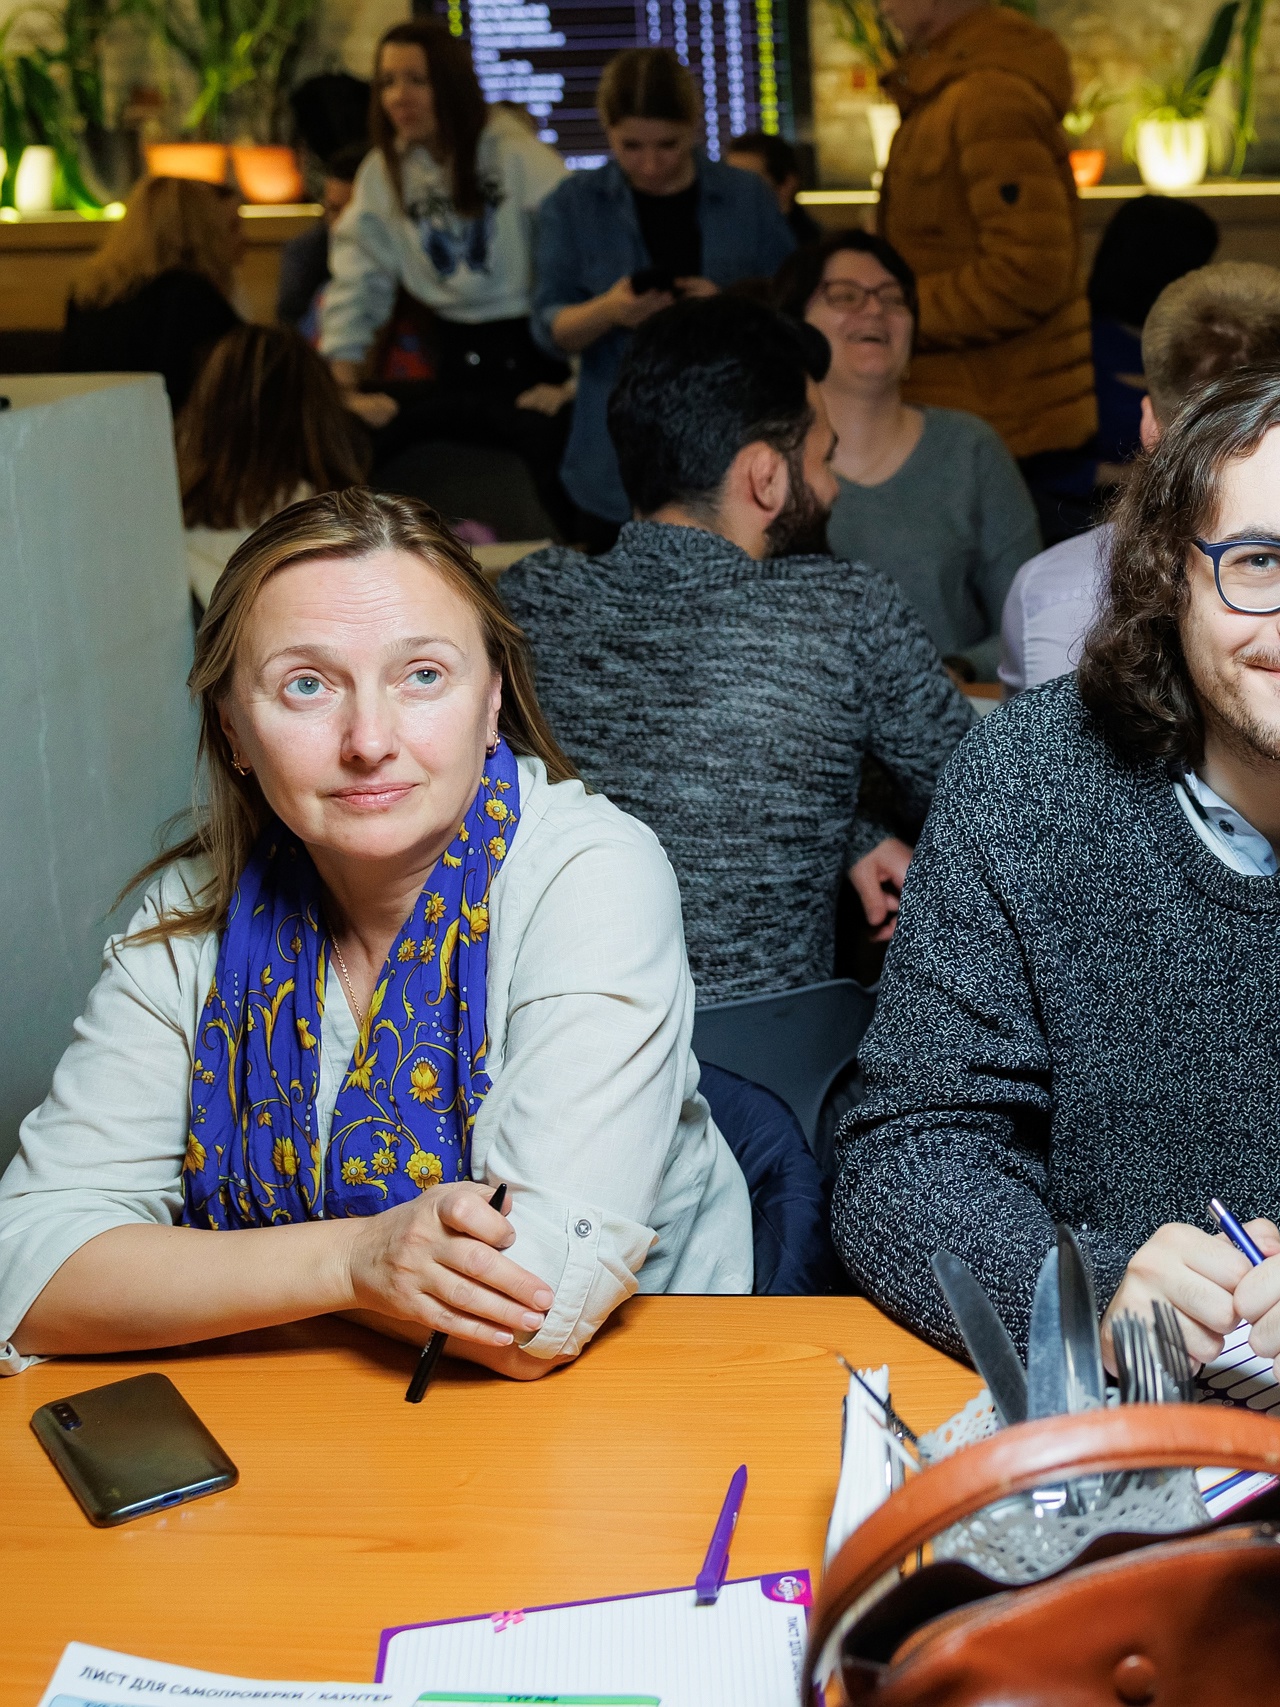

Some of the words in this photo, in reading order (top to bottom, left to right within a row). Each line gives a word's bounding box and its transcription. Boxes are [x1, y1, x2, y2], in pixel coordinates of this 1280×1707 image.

[79, 1666, 128, 1685] ЛИСТ
[129, 1677, 167, 1692] ДЛЯ
[169, 1683, 304, 1700] САМОПРОВЕРКИ
[319, 1692, 393, 1701] КАУНТЕР
